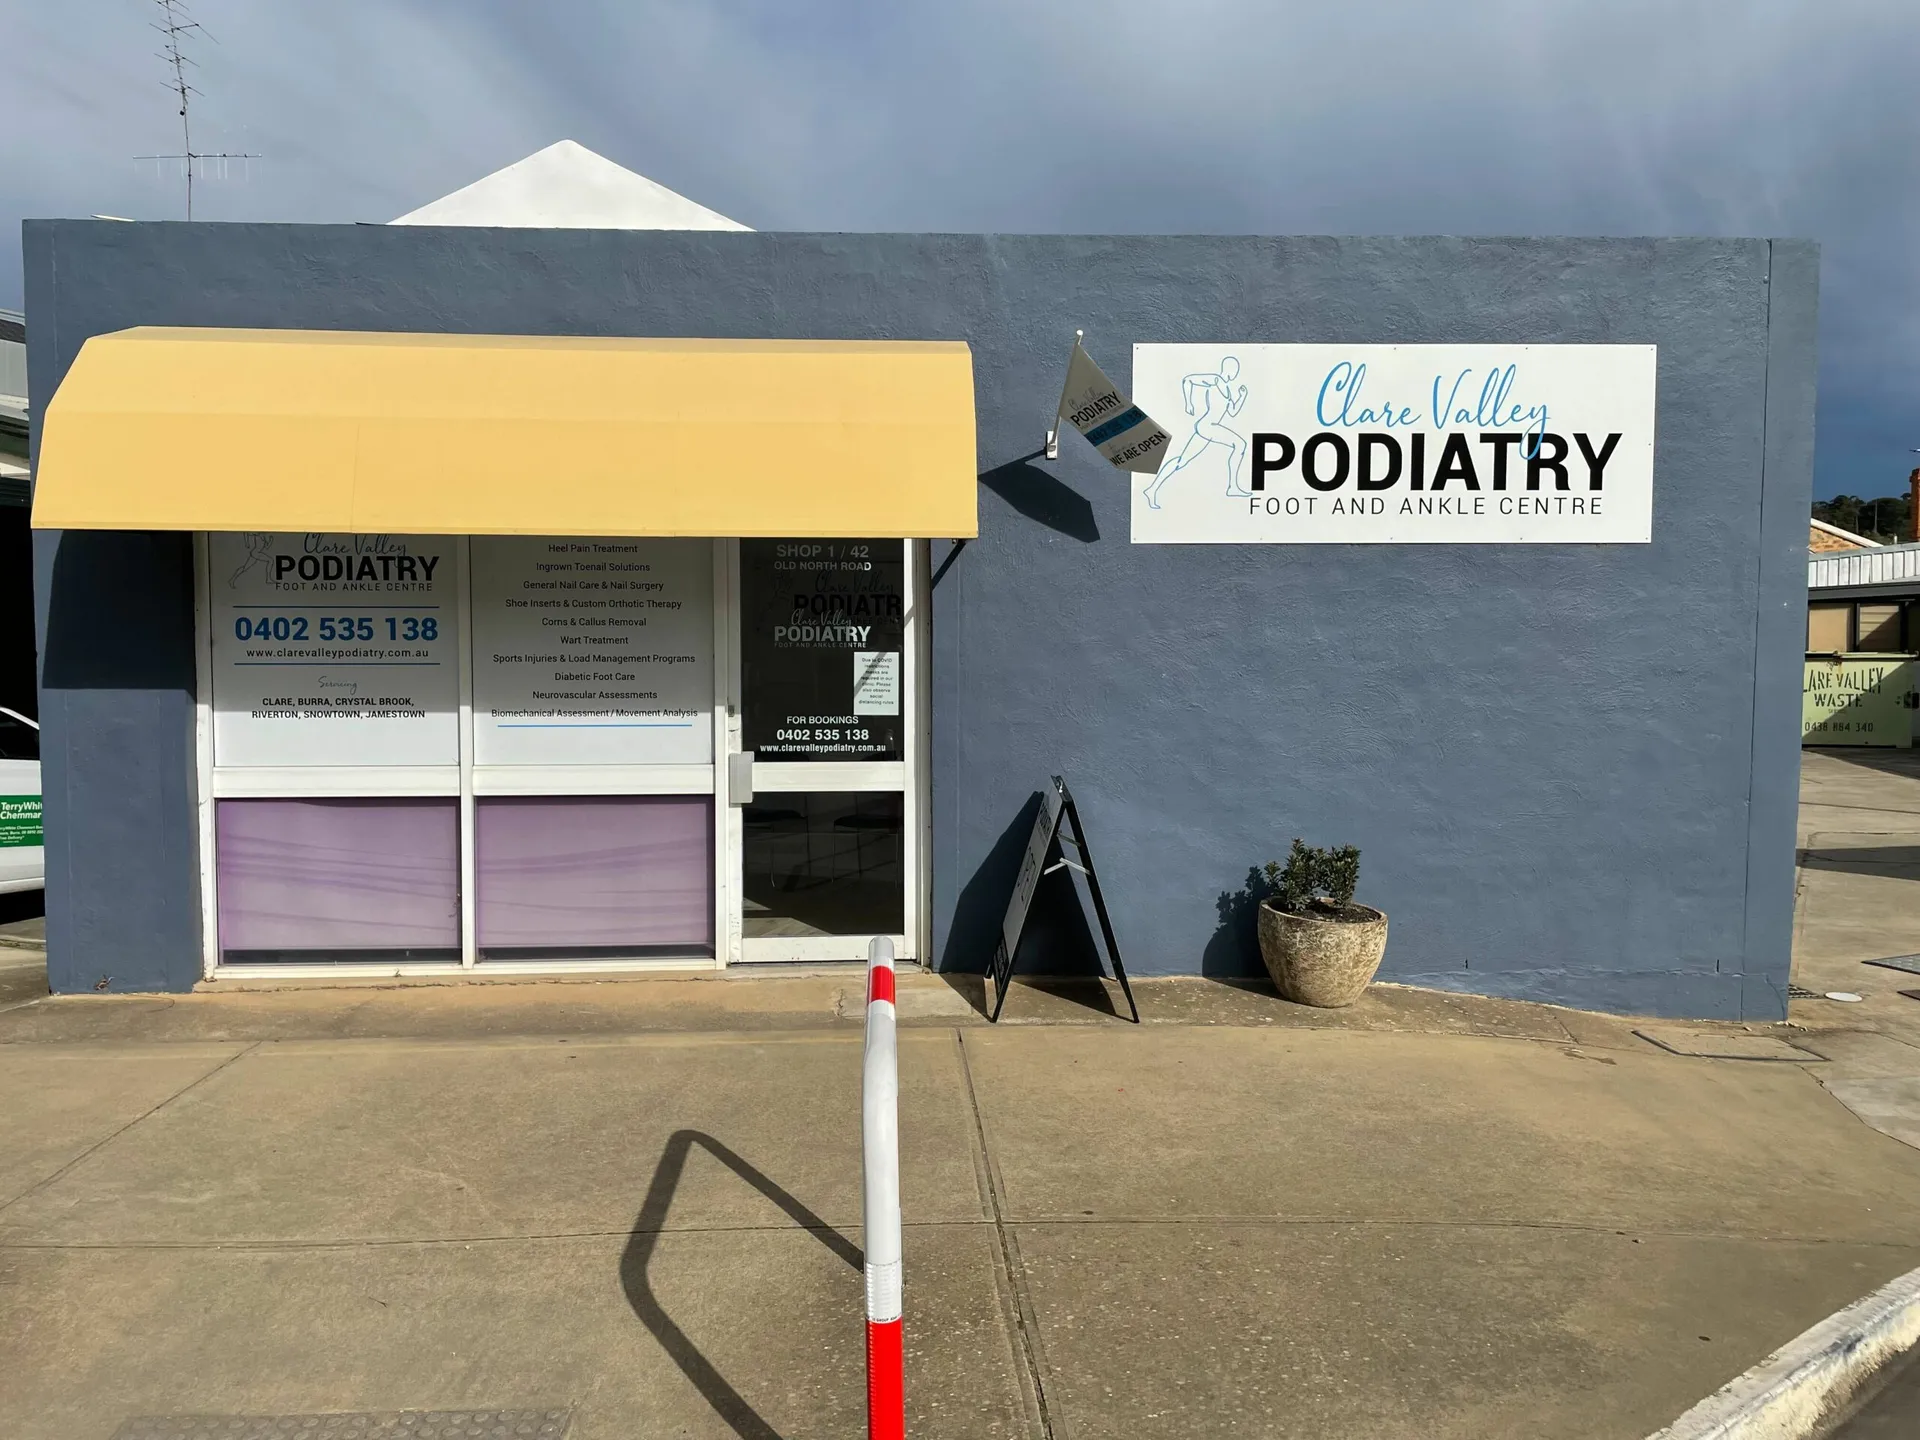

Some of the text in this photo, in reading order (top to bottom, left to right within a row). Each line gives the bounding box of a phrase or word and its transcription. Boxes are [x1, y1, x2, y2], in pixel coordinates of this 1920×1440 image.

[1070, 391, 1120, 426] PODIATRY
[1316, 362, 1551, 460] Clare Valley
[1110, 455, 1125, 466] WE
[1123, 447, 1141, 461] ARE
[1138, 431, 1167, 452] OPEN
[1251, 432, 1622, 492] PODIATRY
[1250, 498, 1602, 515] FOOT AND ANKLE CENTRE
[304, 532, 407, 568] Clare Valley
[548, 544, 637, 553] Heel Pain Treatment
[777, 545, 821, 557] SHOP
[828, 546, 833, 557] 1
[850, 546, 869, 558] 42
[276, 556, 439, 581] PODIATRY
[536, 562, 650, 573] Ingrown Toenail Solutions
[774, 561, 872, 571] OLD NORTH ROAD
[276, 583, 432, 591] FOOT AND ANKLE CENTRE
[523, 581, 664, 592] General Nail Care & Nail Surgery
[506, 599, 682, 610] Shoe Inserts & Custom Orthotic Therapy
[794, 594, 901, 616] PODIATR
[542, 618, 646, 626] Corns & Callus Removal
[791, 609, 818, 625] Clare
[821, 609, 851, 627] Valley
[235, 617, 438, 641] 0402 535 138
[774, 626, 871, 642] PODIATRY
[560, 636, 628, 645] Wart Treatment
[246, 648, 428, 659] www.clarevalleypodiatry.com.au
[493, 654, 695, 665] Sports Injuries & Load Management Programs
[555, 672, 635, 681] Diabetic Foot Care
[1836, 667, 1883, 694] VALLEY
[533, 691, 657, 699] Neurovascular Assessments
[1814, 694, 1863, 707] WASTE
[262, 698, 414, 707] CLARE, BURRA, CRYSTAL BROOK,
[252, 710, 425, 719] RIVERTON, SNOWTOWN, JAMESTOWN
[492, 709, 555, 718] Biomechanical
[557, 709, 609, 718] Assessment
[616, 709, 660, 718] Movement
[663, 709, 698, 720] Analysis
[787, 716, 859, 724] FOR BOOKINGS
[1805, 722, 1828, 731] 0438
[1856, 722, 1873, 732] 340
[777, 729, 869, 740] 0402 535 138
[760, 744, 886, 752] www.clarevalleypodiatry.com.au
[1, 802, 42, 812] TerryWhit
[0, 811, 41, 819] Chemmar
